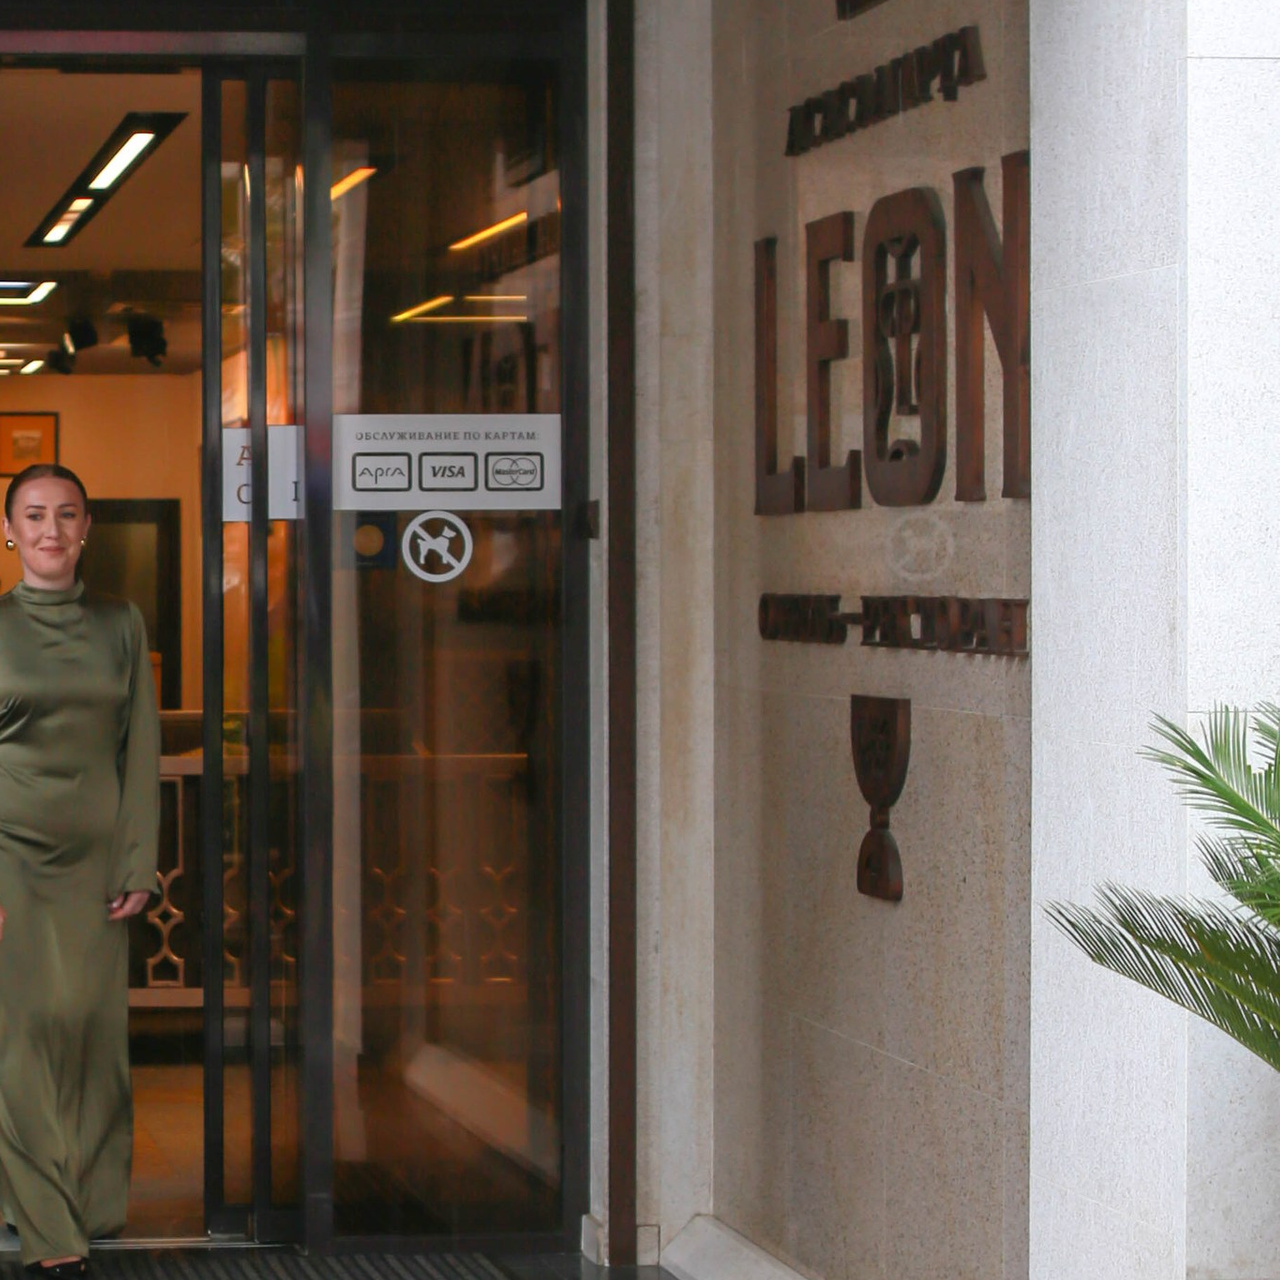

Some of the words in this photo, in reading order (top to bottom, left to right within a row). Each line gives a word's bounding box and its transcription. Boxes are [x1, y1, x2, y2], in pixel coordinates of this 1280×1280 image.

[754, 150, 1031, 516] LEON
[355, 431, 460, 441] ОБСЛУЖИВАНИЕ
[463, 431, 481, 441] ПО
[430, 465, 466, 478] VISA
